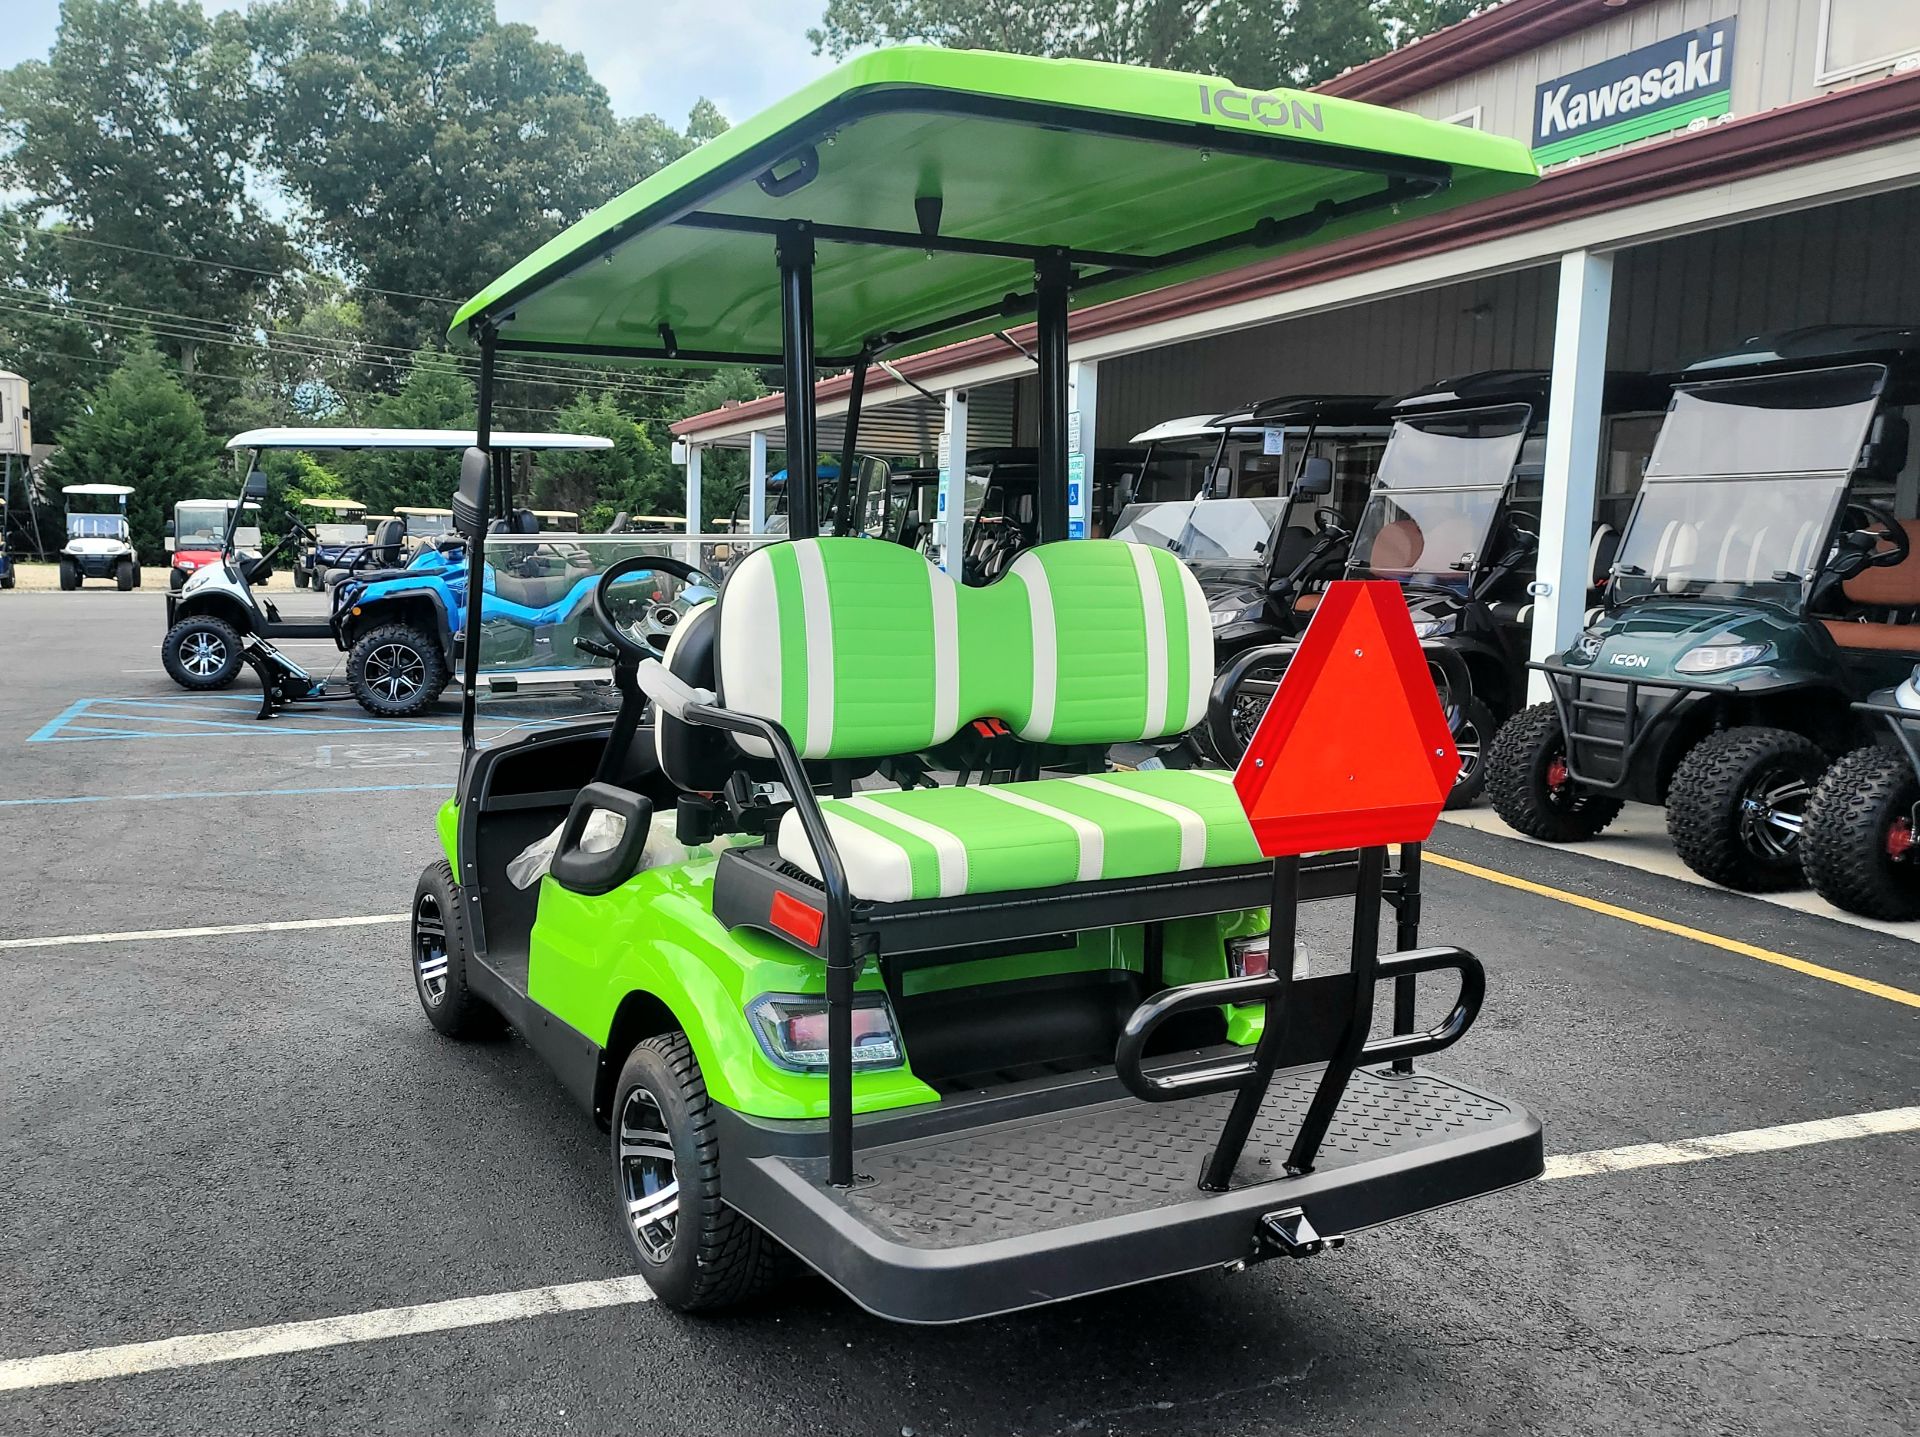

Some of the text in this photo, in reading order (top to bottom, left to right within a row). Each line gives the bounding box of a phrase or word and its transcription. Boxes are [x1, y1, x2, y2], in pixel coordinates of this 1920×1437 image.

[1540, 31, 1724, 138] Kawasaki
[1199, 85, 1324, 132] ICON
[1609, 653, 1650, 668] ICON
